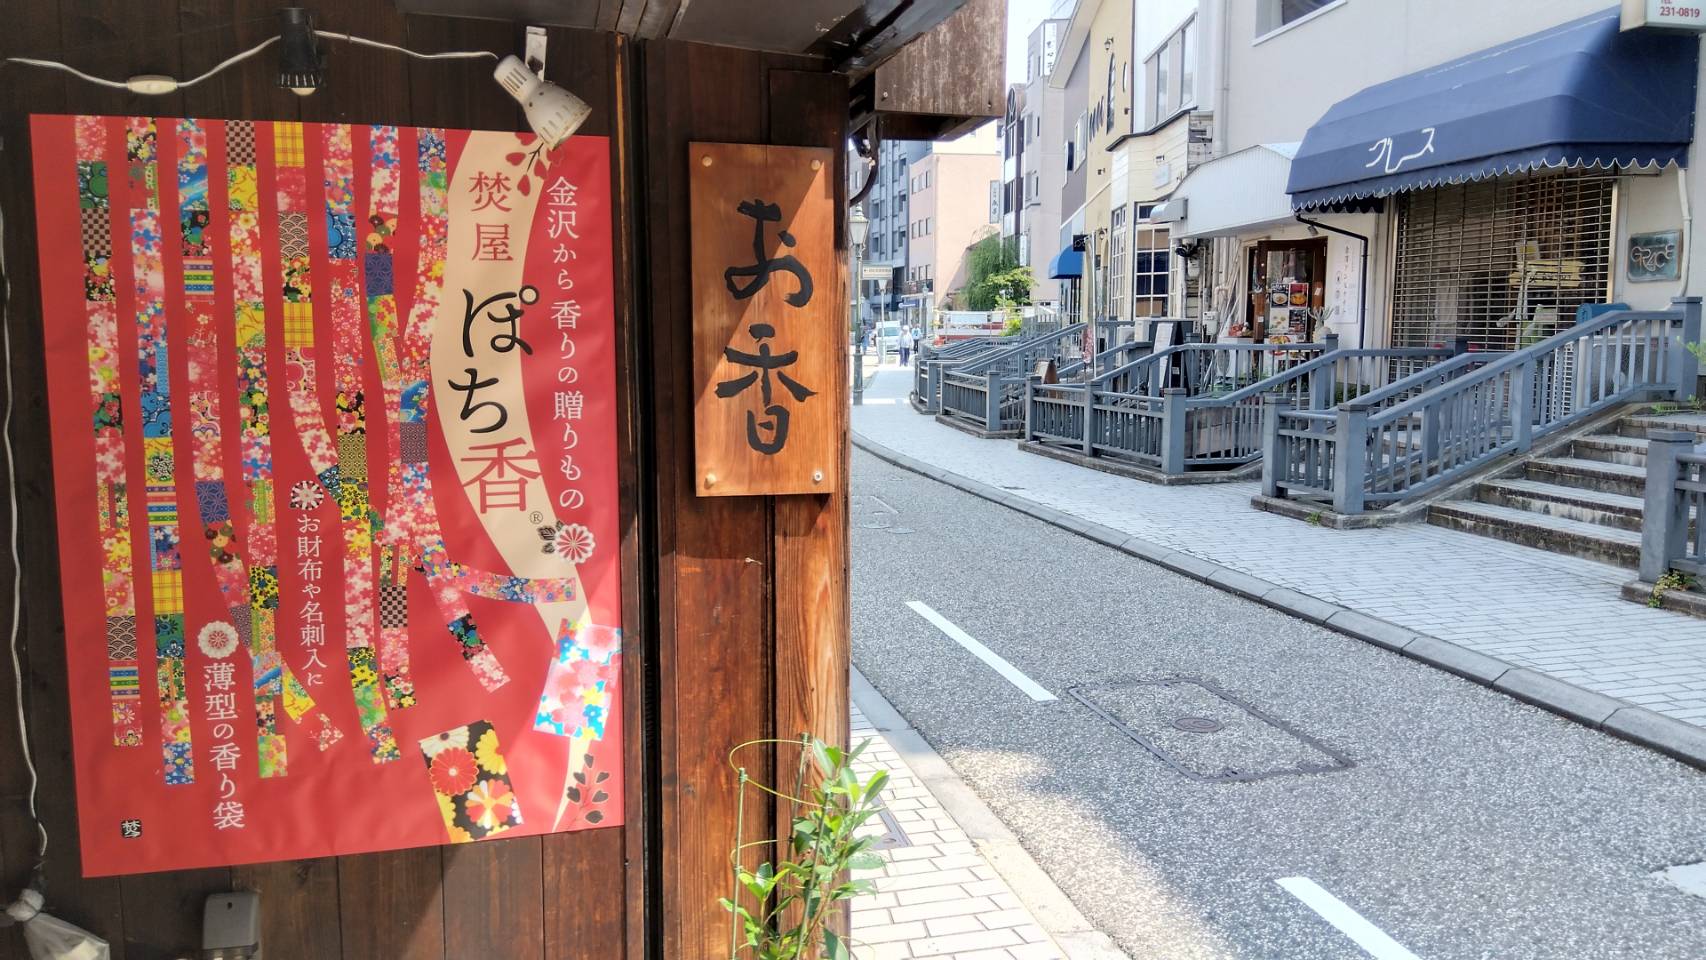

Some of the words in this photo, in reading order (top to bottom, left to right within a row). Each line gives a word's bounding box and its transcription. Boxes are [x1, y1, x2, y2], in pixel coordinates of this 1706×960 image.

[1660, 6, 1700, 18] 231-0819
[547, 176, 584, 509] 金沢から香りの贈りもの
[714, 198, 818, 455] お香
[1631, 243, 1675, 272] GRACE
[297, 514, 327, 687] お財布や名刺入に
[203, 662, 246, 830] 薄型の香り袋
